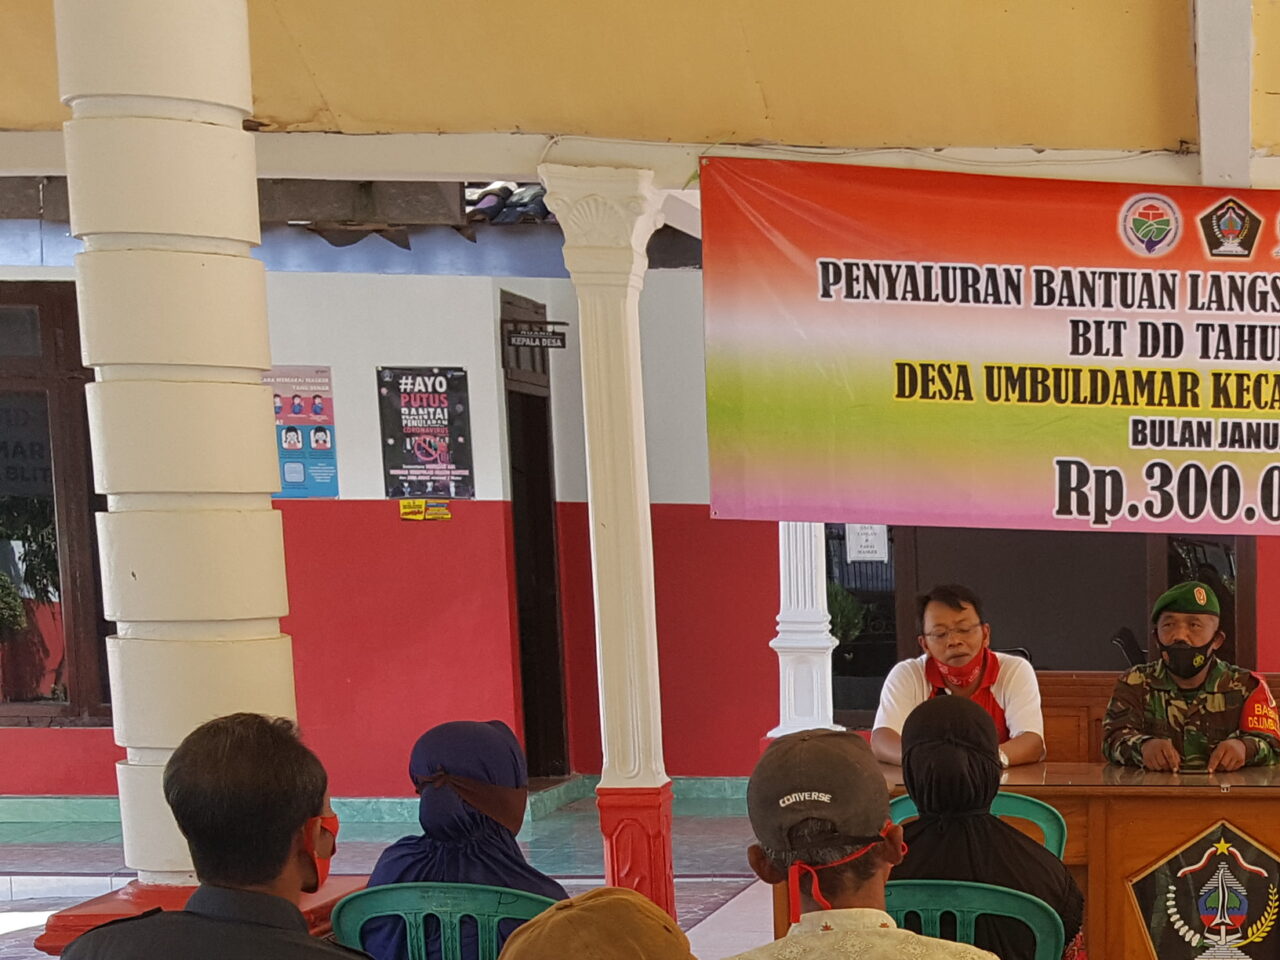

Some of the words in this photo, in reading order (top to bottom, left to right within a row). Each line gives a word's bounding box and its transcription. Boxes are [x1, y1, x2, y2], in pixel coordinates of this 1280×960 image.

[819, 261, 1022, 305] PENYALURAN
[1033, 269, 1178, 310] BANTUAN
[511, 337, 540, 346] KEPALA
[542, 338, 562, 347] DESA
[1069, 319, 1127, 357] BLT
[1138, 321, 1184, 359] DD
[399, 376, 447, 392] #AYO
[895, 362, 974, 401] DESA
[984, 365, 1200, 408] UMBULDAMAR
[401, 393, 448, 408] PUTUS
[1132, 419, 1212, 448] BULAN
[779, 792, 832, 807] CONVERSE
